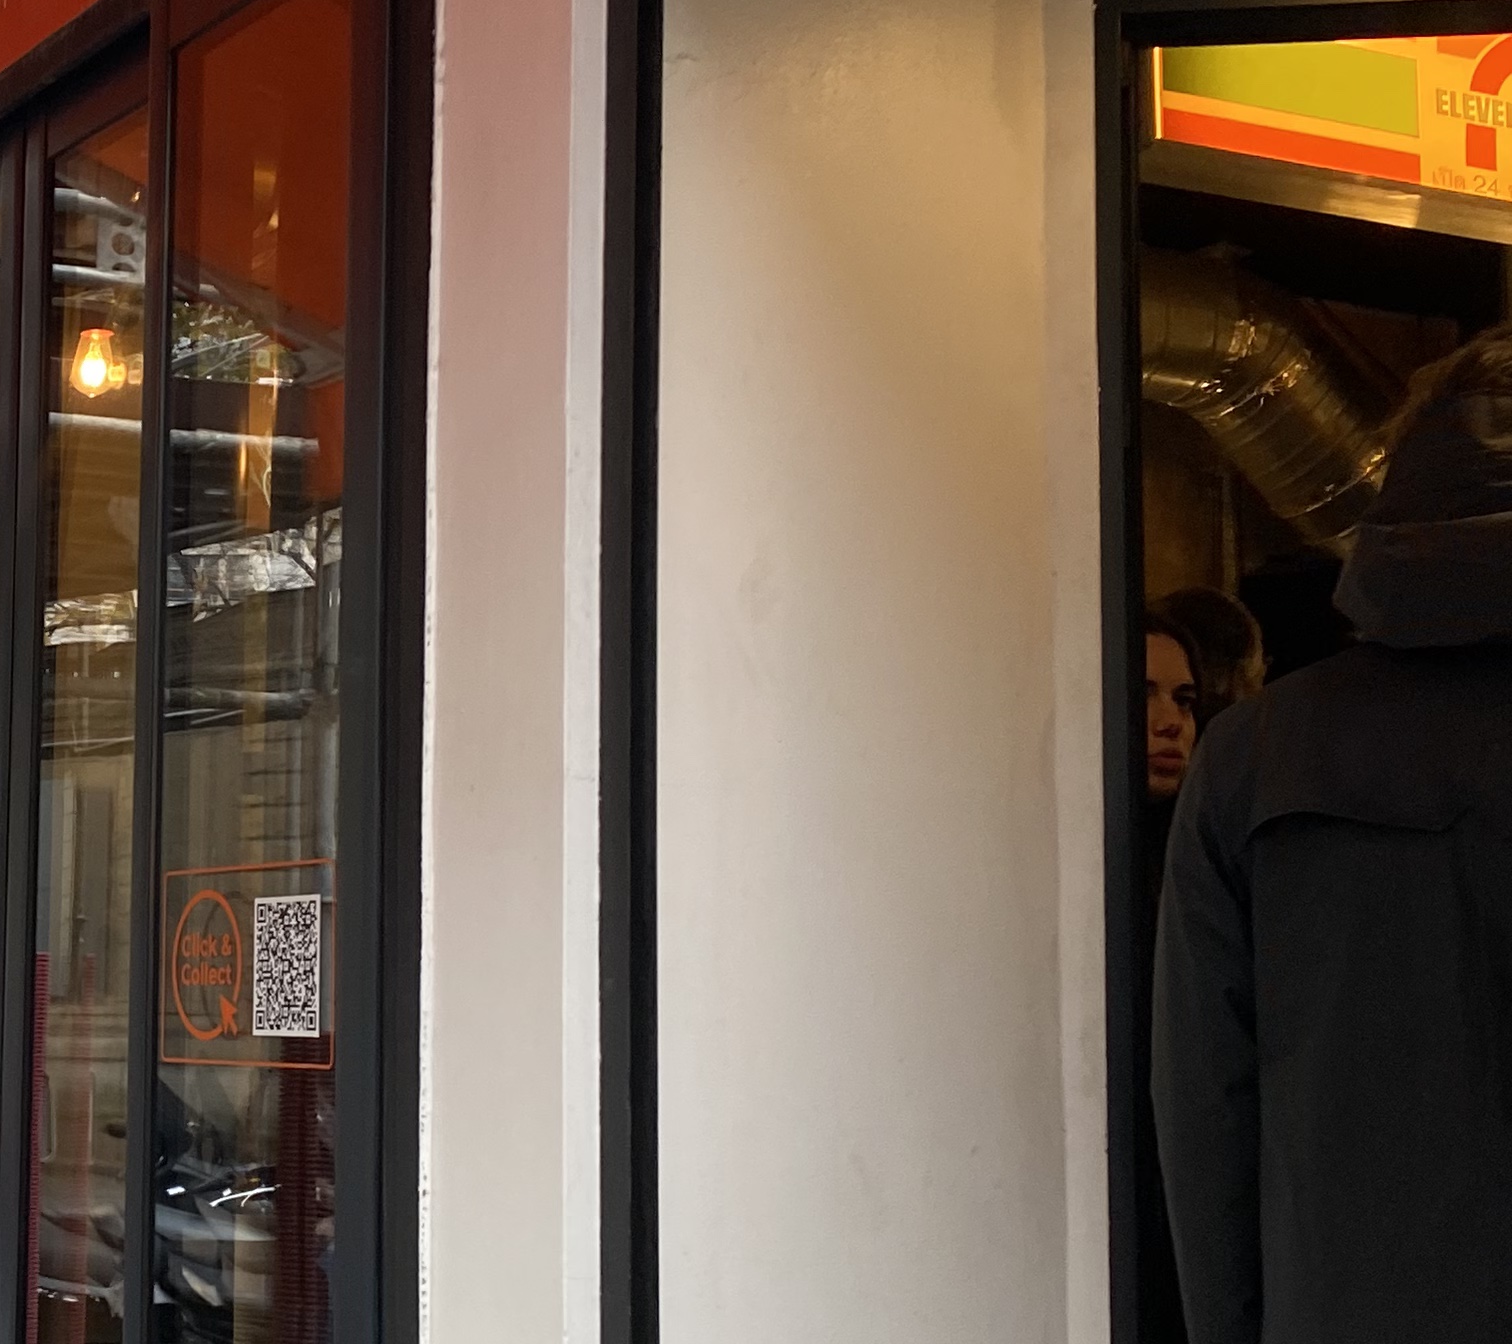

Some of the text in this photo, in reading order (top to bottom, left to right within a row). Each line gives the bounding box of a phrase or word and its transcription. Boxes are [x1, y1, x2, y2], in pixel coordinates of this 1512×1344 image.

[1473, 174, 1500, 197] 24
[182, 932, 232, 957] Click &
[181, 961, 232, 986] Collect
